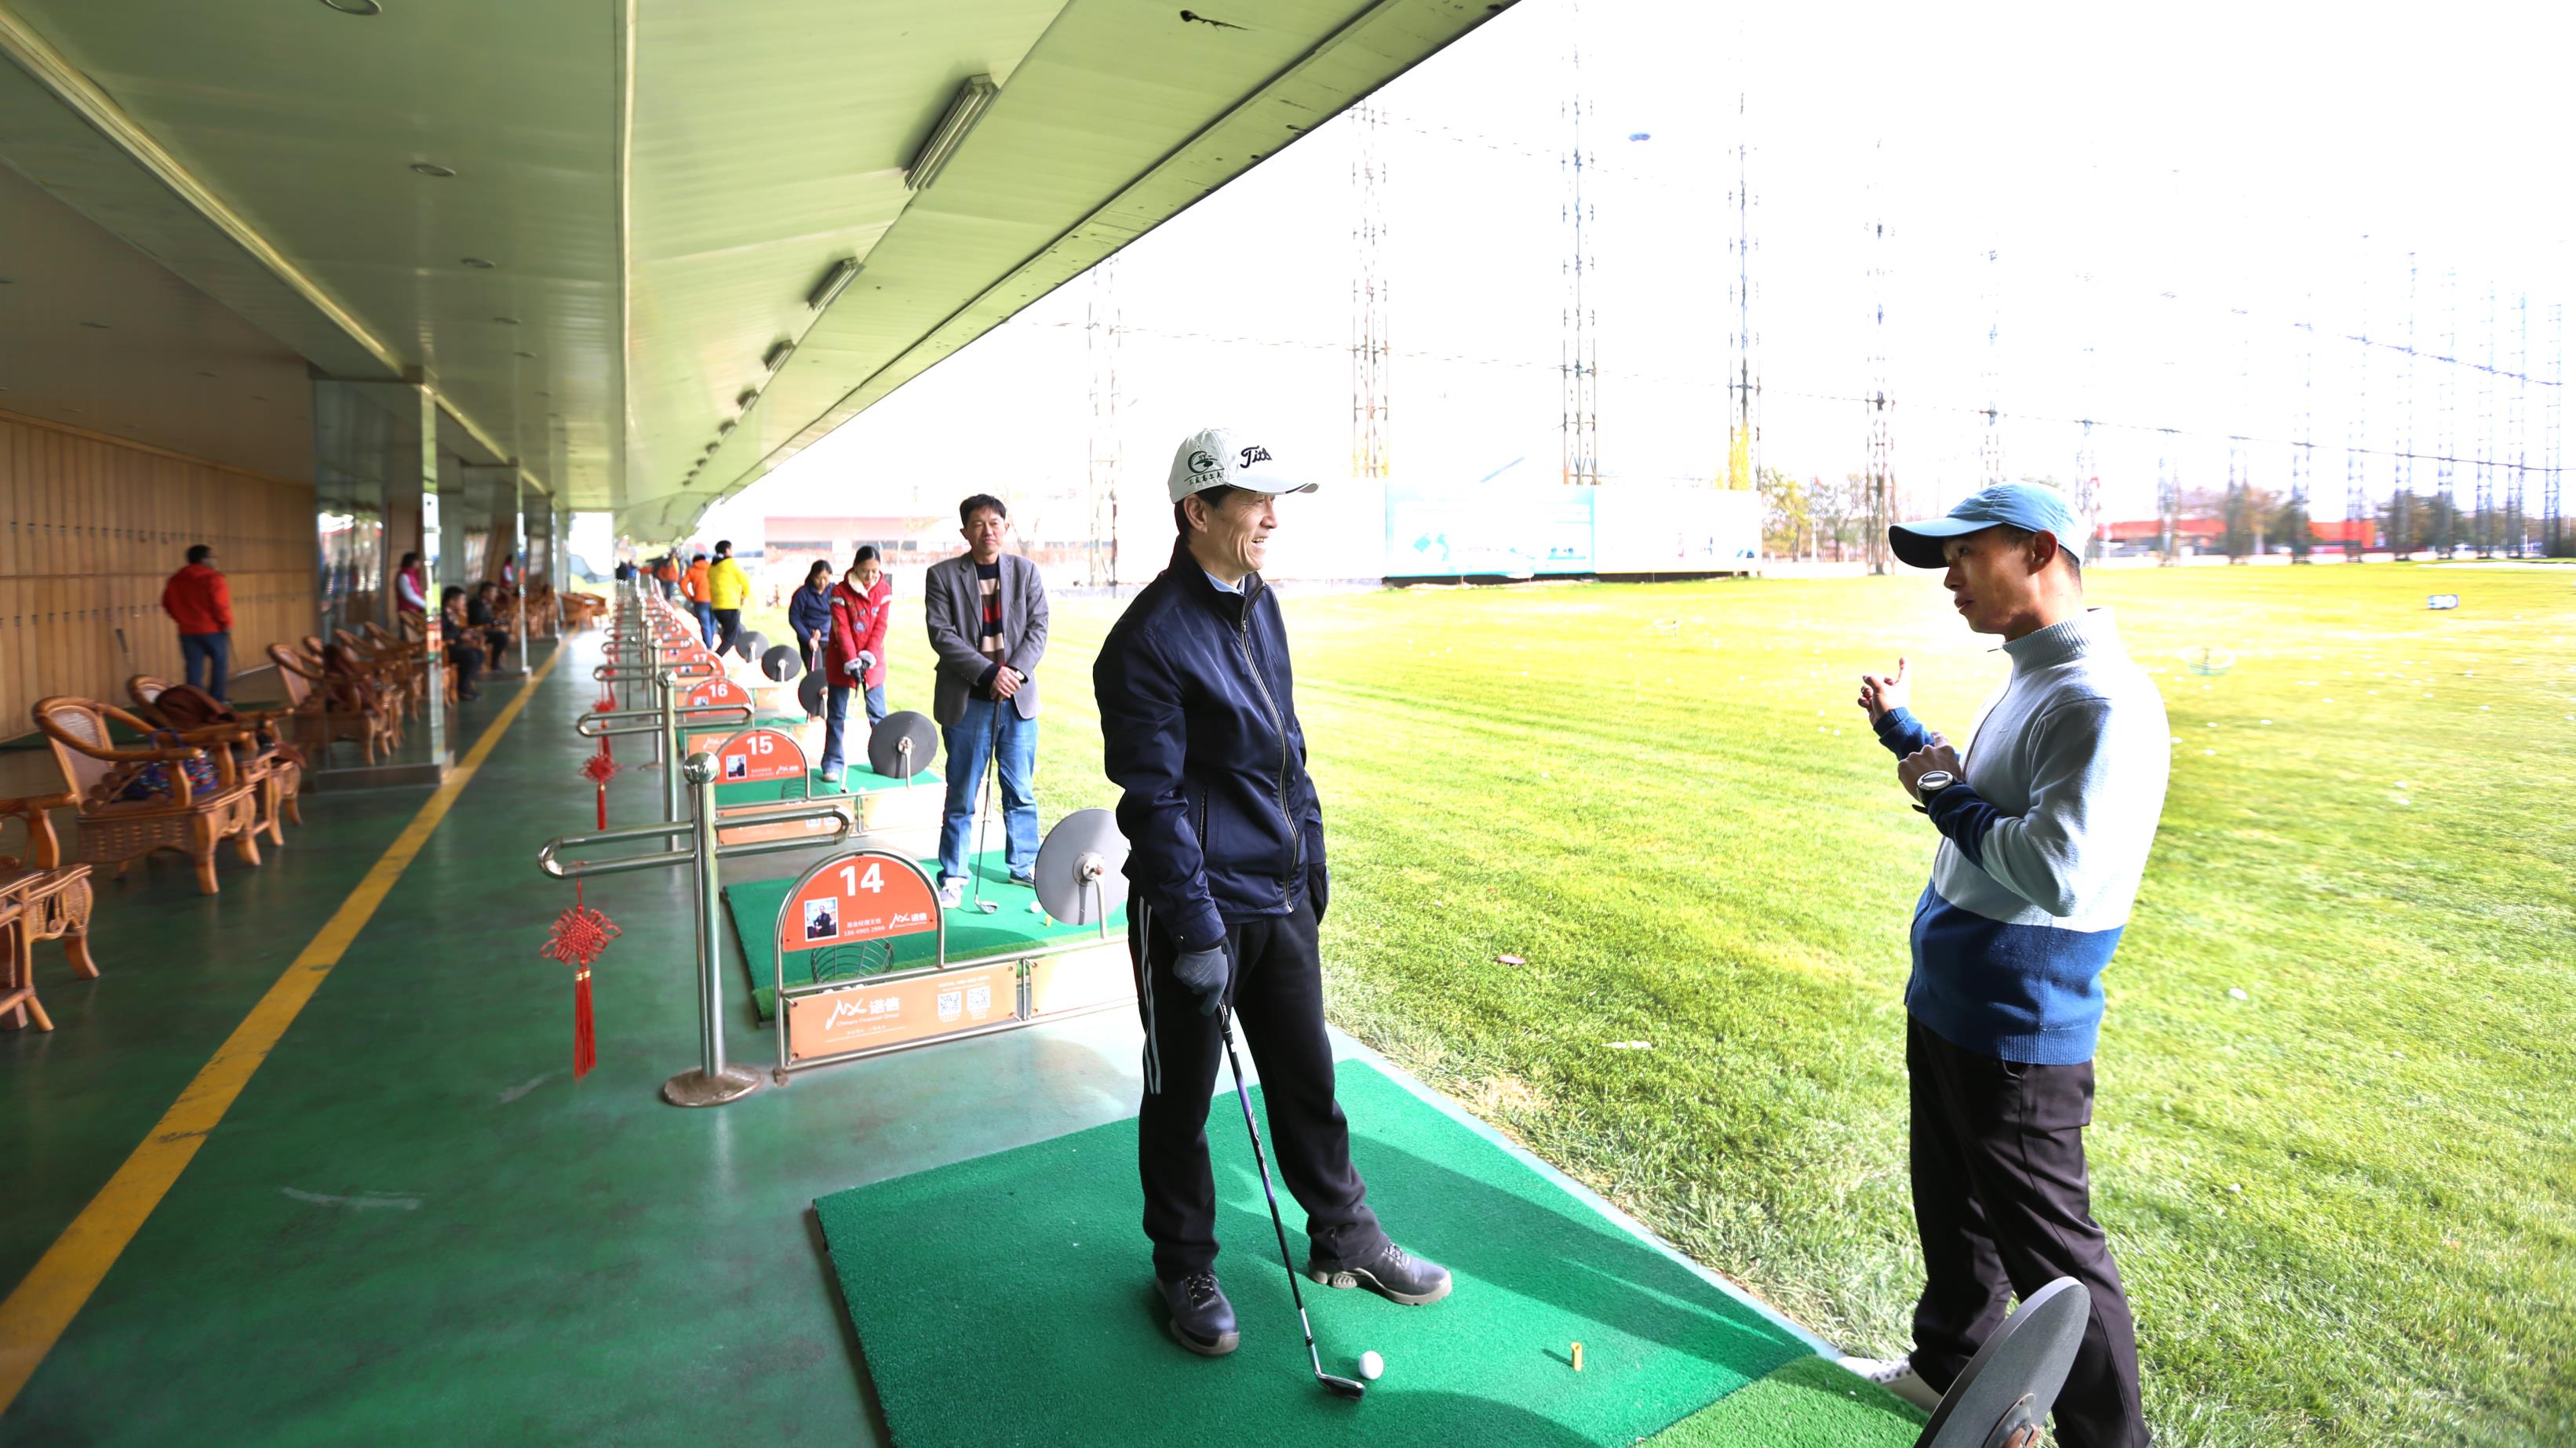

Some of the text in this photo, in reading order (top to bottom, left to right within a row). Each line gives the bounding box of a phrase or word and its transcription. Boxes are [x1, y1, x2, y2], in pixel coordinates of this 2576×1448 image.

[693, 653, 707, 663] 17
[709, 684, 728, 697] 16
[747, 736, 774, 755] 15
[840, 863, 884, 897] 14
